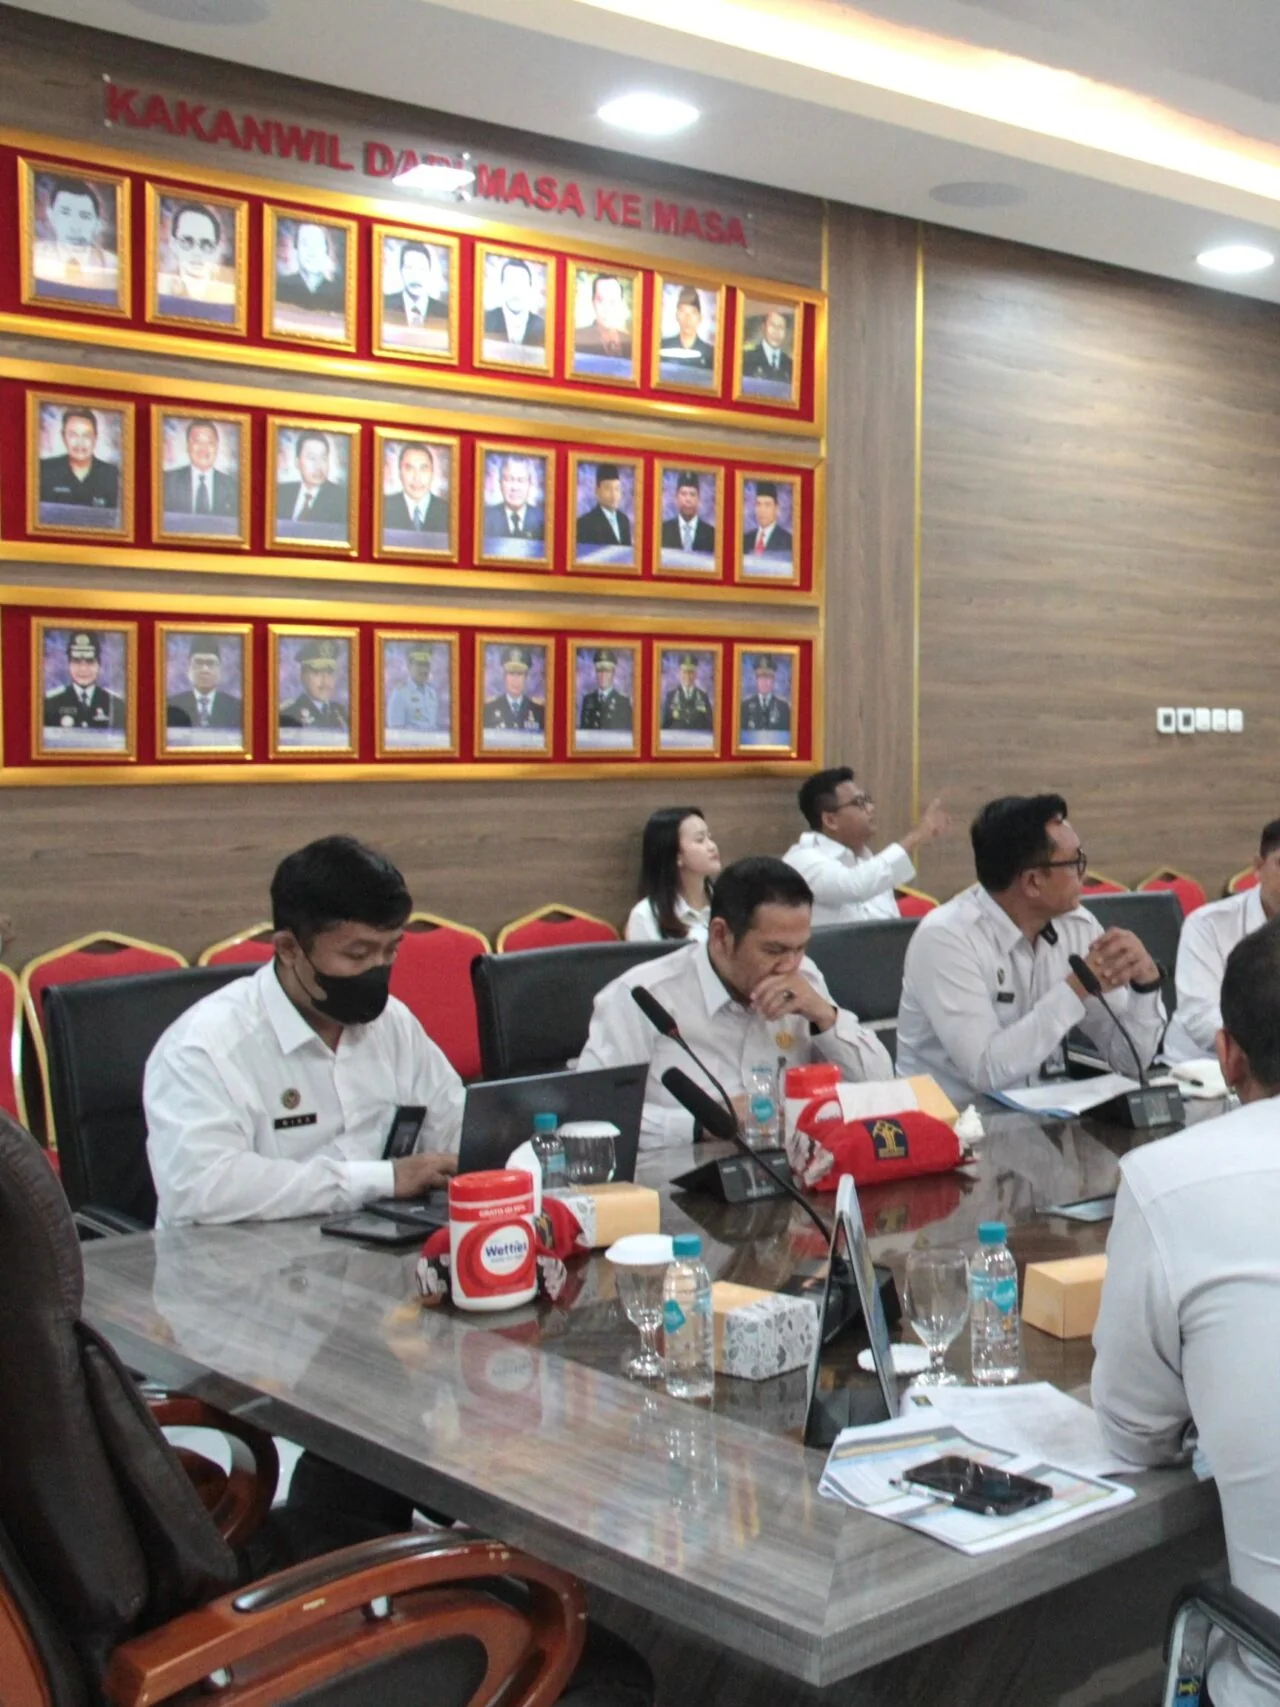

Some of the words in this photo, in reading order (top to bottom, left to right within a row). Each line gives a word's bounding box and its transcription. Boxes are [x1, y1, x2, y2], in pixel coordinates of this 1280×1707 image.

[104, 83, 353, 170] KAKANWIL
[476, 163, 585, 218] MASA
[594, 188, 642, 228] KE
[652, 198, 748, 248] MASA
